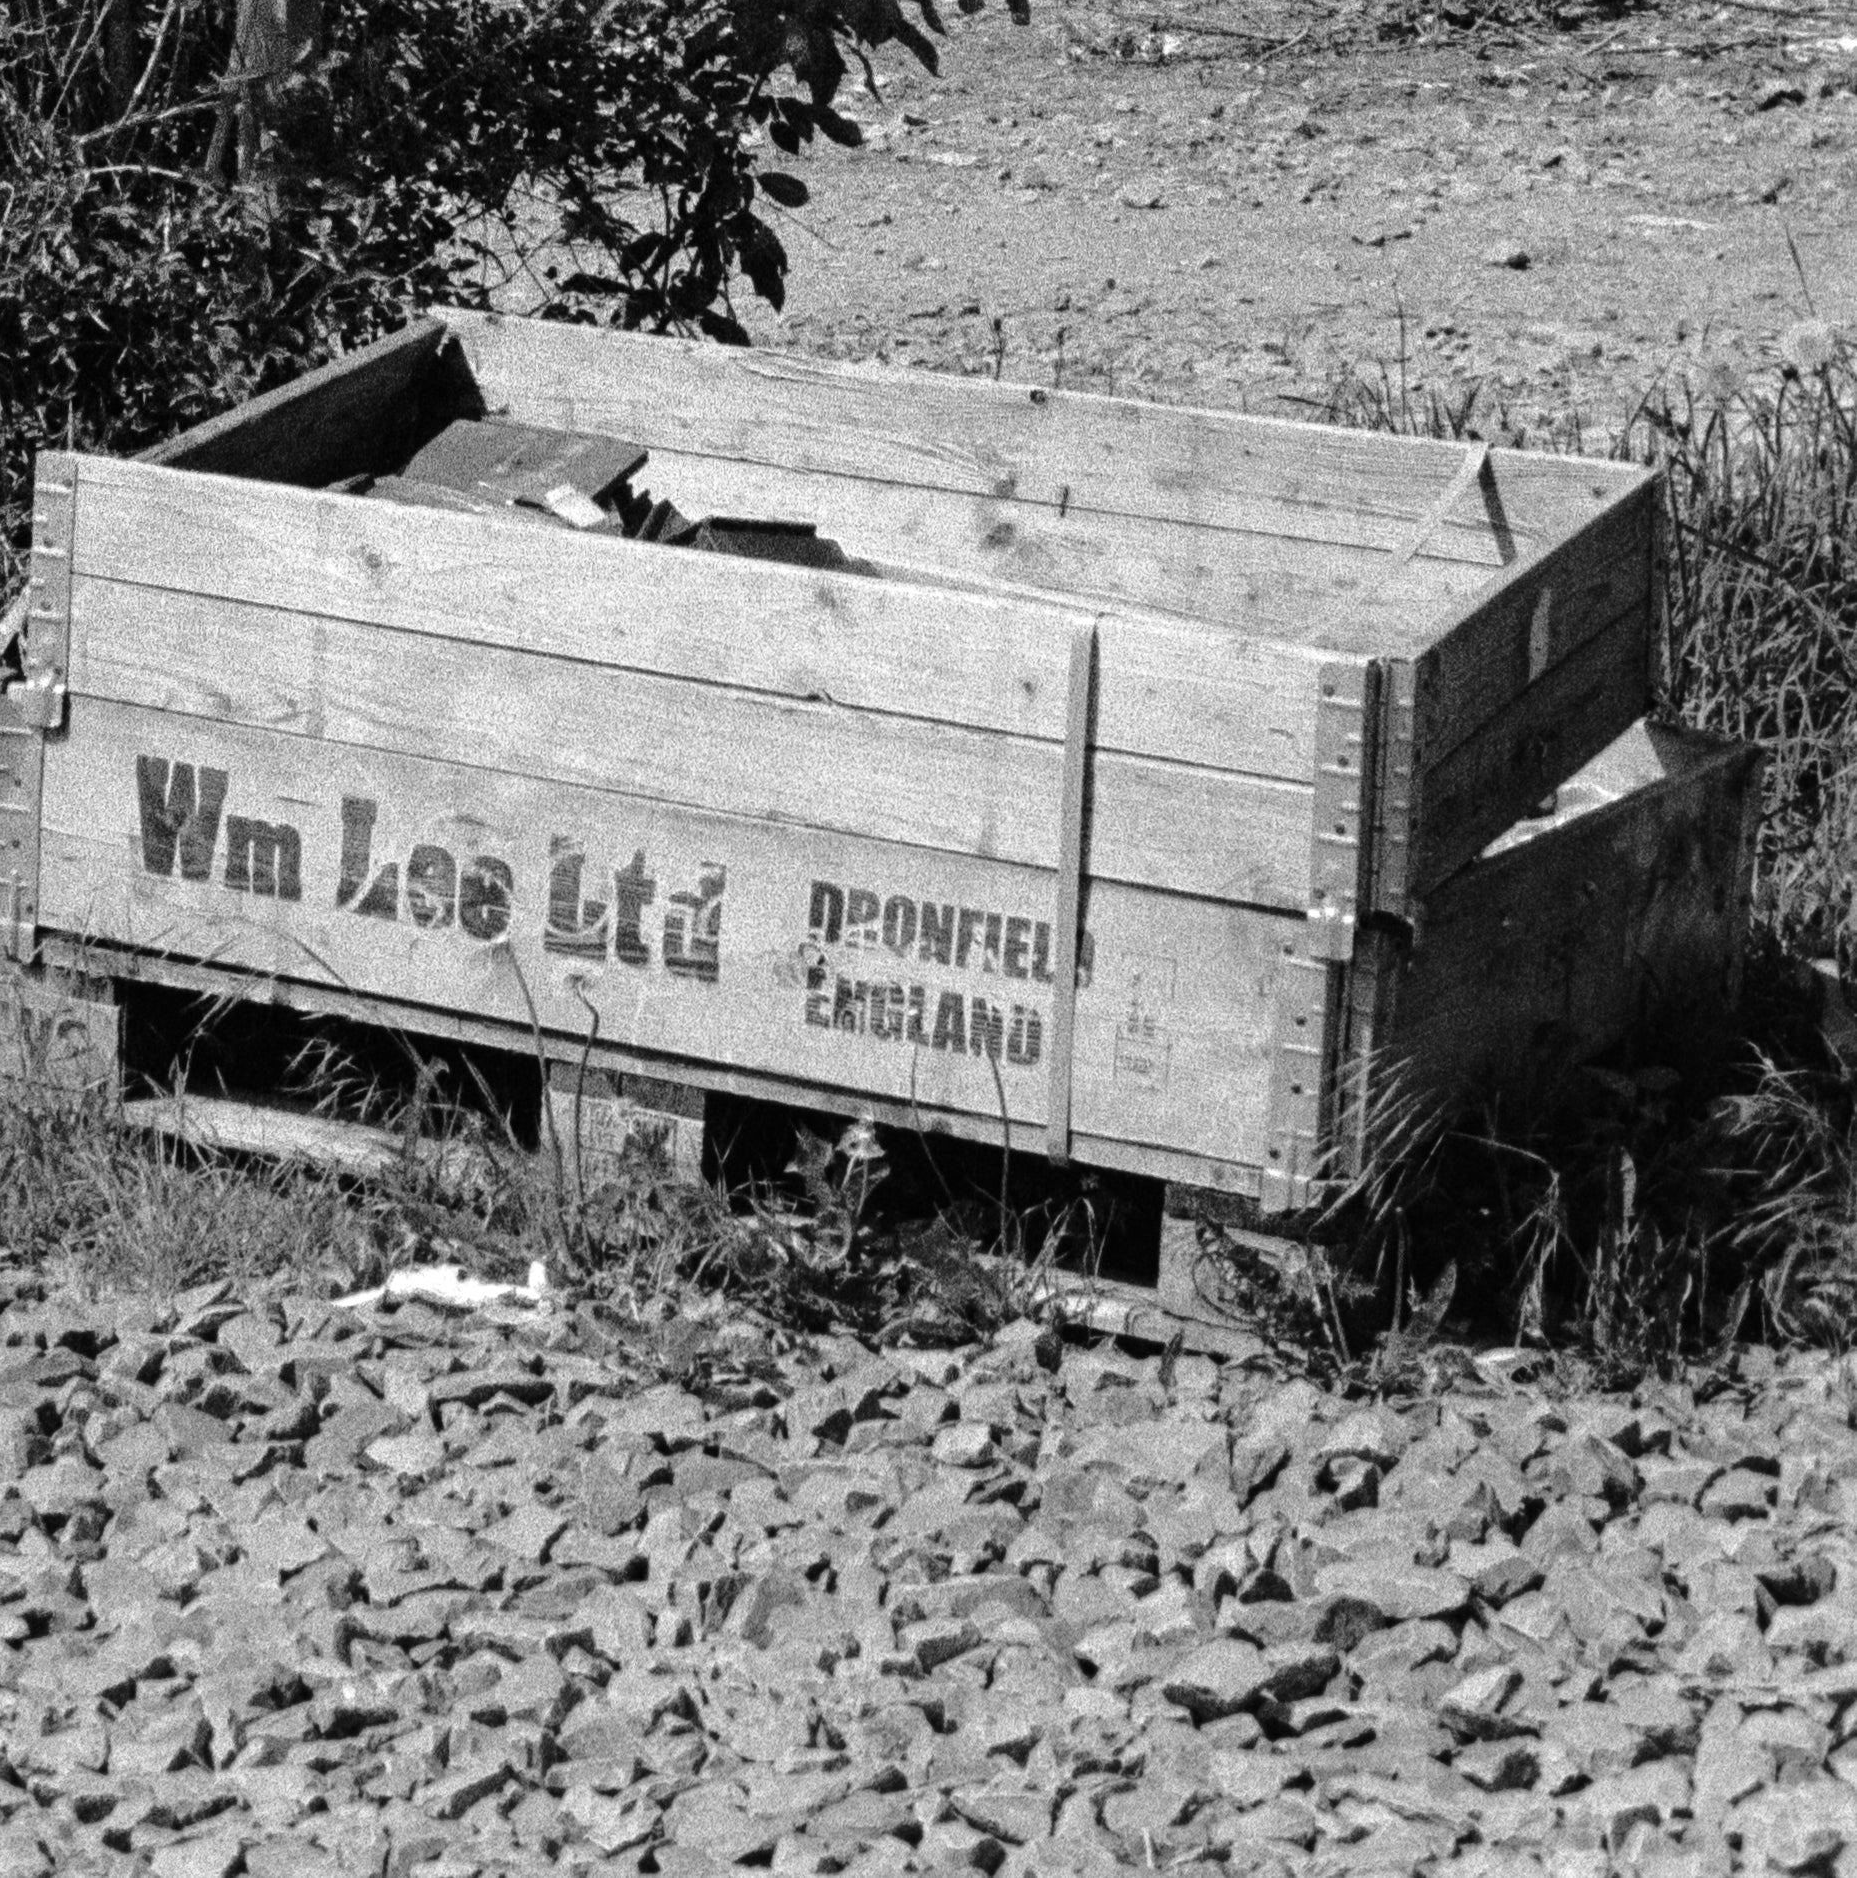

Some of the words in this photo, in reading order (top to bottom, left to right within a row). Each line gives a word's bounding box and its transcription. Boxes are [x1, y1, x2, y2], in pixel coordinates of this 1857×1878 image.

[135, 753, 304, 903] Wm
[336, 795, 515, 943] Lee
[543, 833, 729, 984] Ltd
[803, 964, 1043, 1066] ENGLAND
